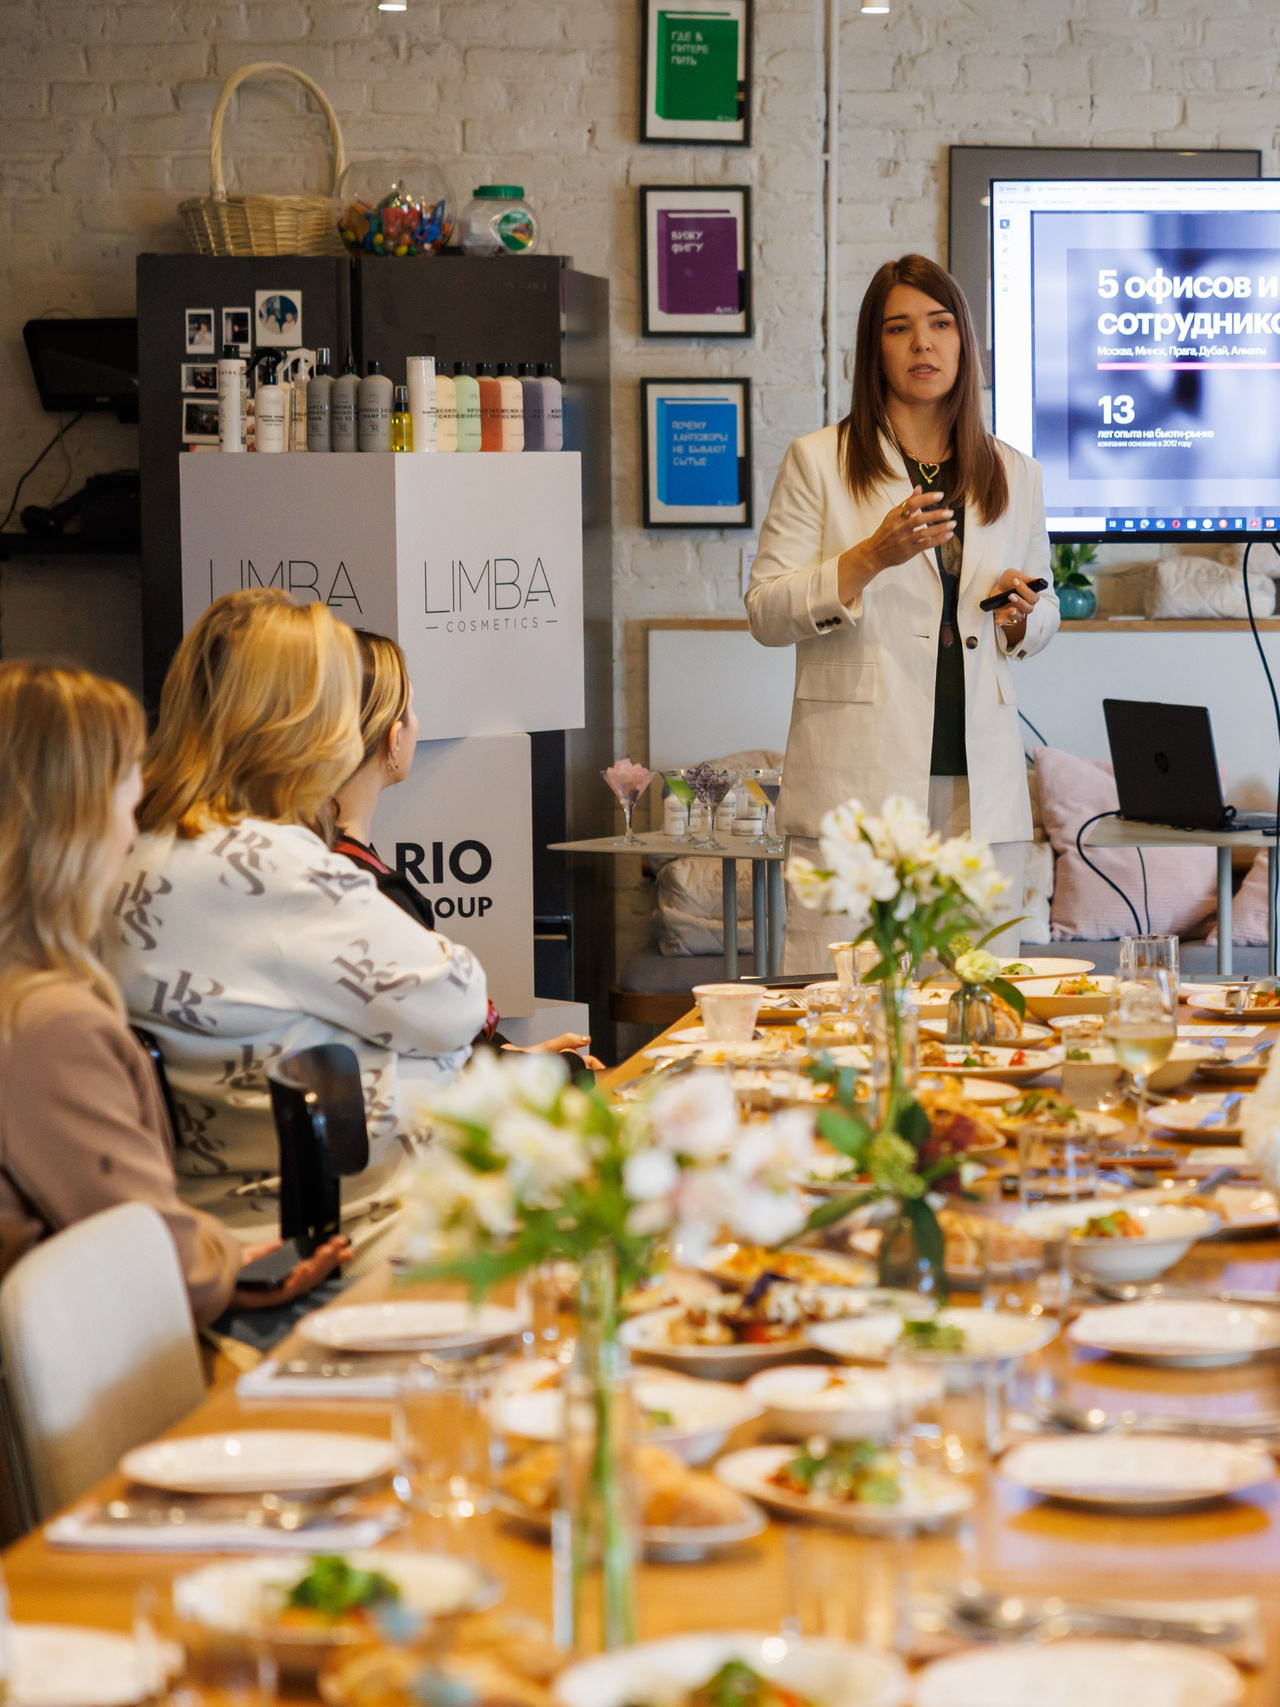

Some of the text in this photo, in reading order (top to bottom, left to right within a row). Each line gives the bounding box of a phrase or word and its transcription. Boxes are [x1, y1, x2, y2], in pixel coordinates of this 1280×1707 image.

[671, 230, 703, 240] ВИЖУ
[671, 243, 704, 255] ФИГУ
[1097, 269, 1119, 298] 5
[1124, 268, 1252, 304] офисов
[1258, 276, 1278, 298] и
[1097, 346, 1134, 357] Москва,
[1169, 345, 1199, 358] Прага,
[1199, 344, 1230, 358] Дубай,
[1231, 345, 1267, 356] Алматы
[1097, 395, 1135, 425] 13
[672, 421, 707, 429] ПОЧЕМУ
[1097, 430, 1114, 439] лет
[1114, 430, 1142, 439] опыта
[1143, 430, 1154, 439] на
[673, 445, 727, 454] НЕ БЫВАЮТ
[673, 457, 707, 466] СЫТЫЕ
[425, 557, 556, 613] LIMBA
[446, 617, 539, 633] COSMETICS
[369, 840, 492, 884] RIO
[426, 897, 493, 919] OUP
